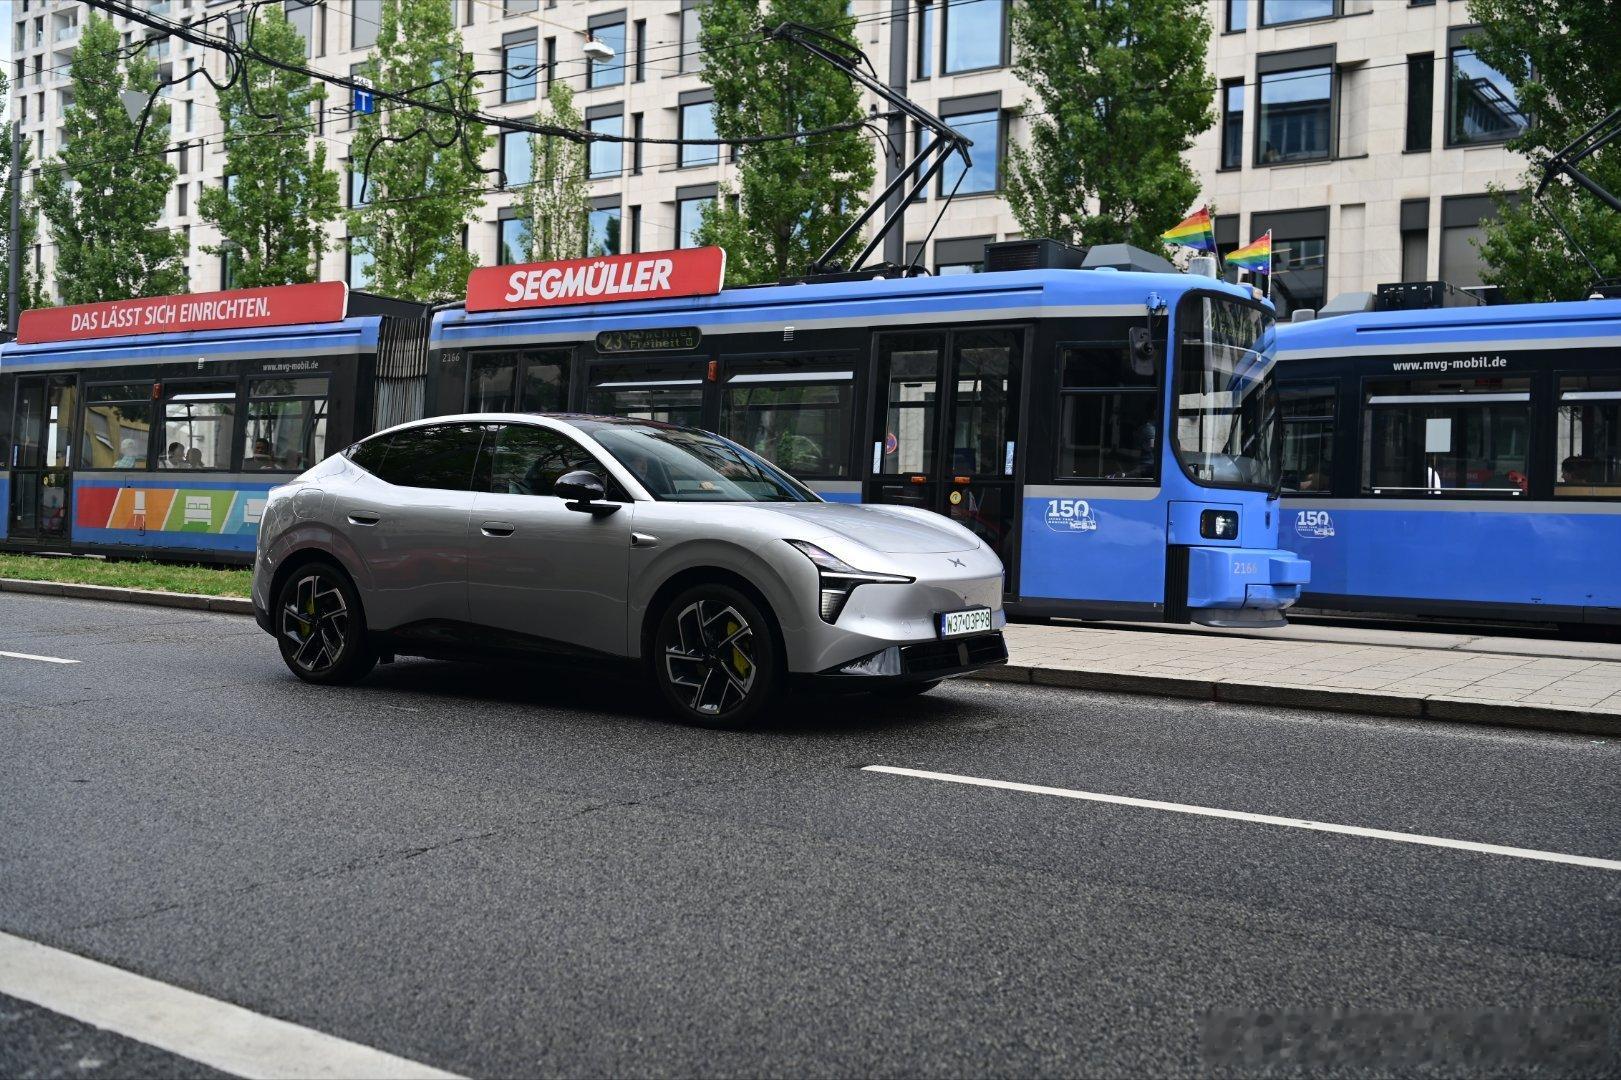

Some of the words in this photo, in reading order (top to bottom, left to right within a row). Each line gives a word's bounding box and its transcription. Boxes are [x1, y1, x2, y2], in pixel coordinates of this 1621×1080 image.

[505, 258, 673, 302] SEGMÜLLER
[71, 311, 98, 332] DAS
[101, 305, 142, 329] LÄSST
[145, 303, 176, 325] SICH
[179, 297, 271, 323] EINRICHTEN.
[630, 338, 680, 349] Freiheit
[442, 352, 460, 363] 2166
[1393, 356, 1507, 372] www.mvg-mobil.de
[262, 360, 319, 373] www.mvg-mobil.de
[1048, 499, 1090, 518] 150
[1297, 511, 1329, 526] 150
